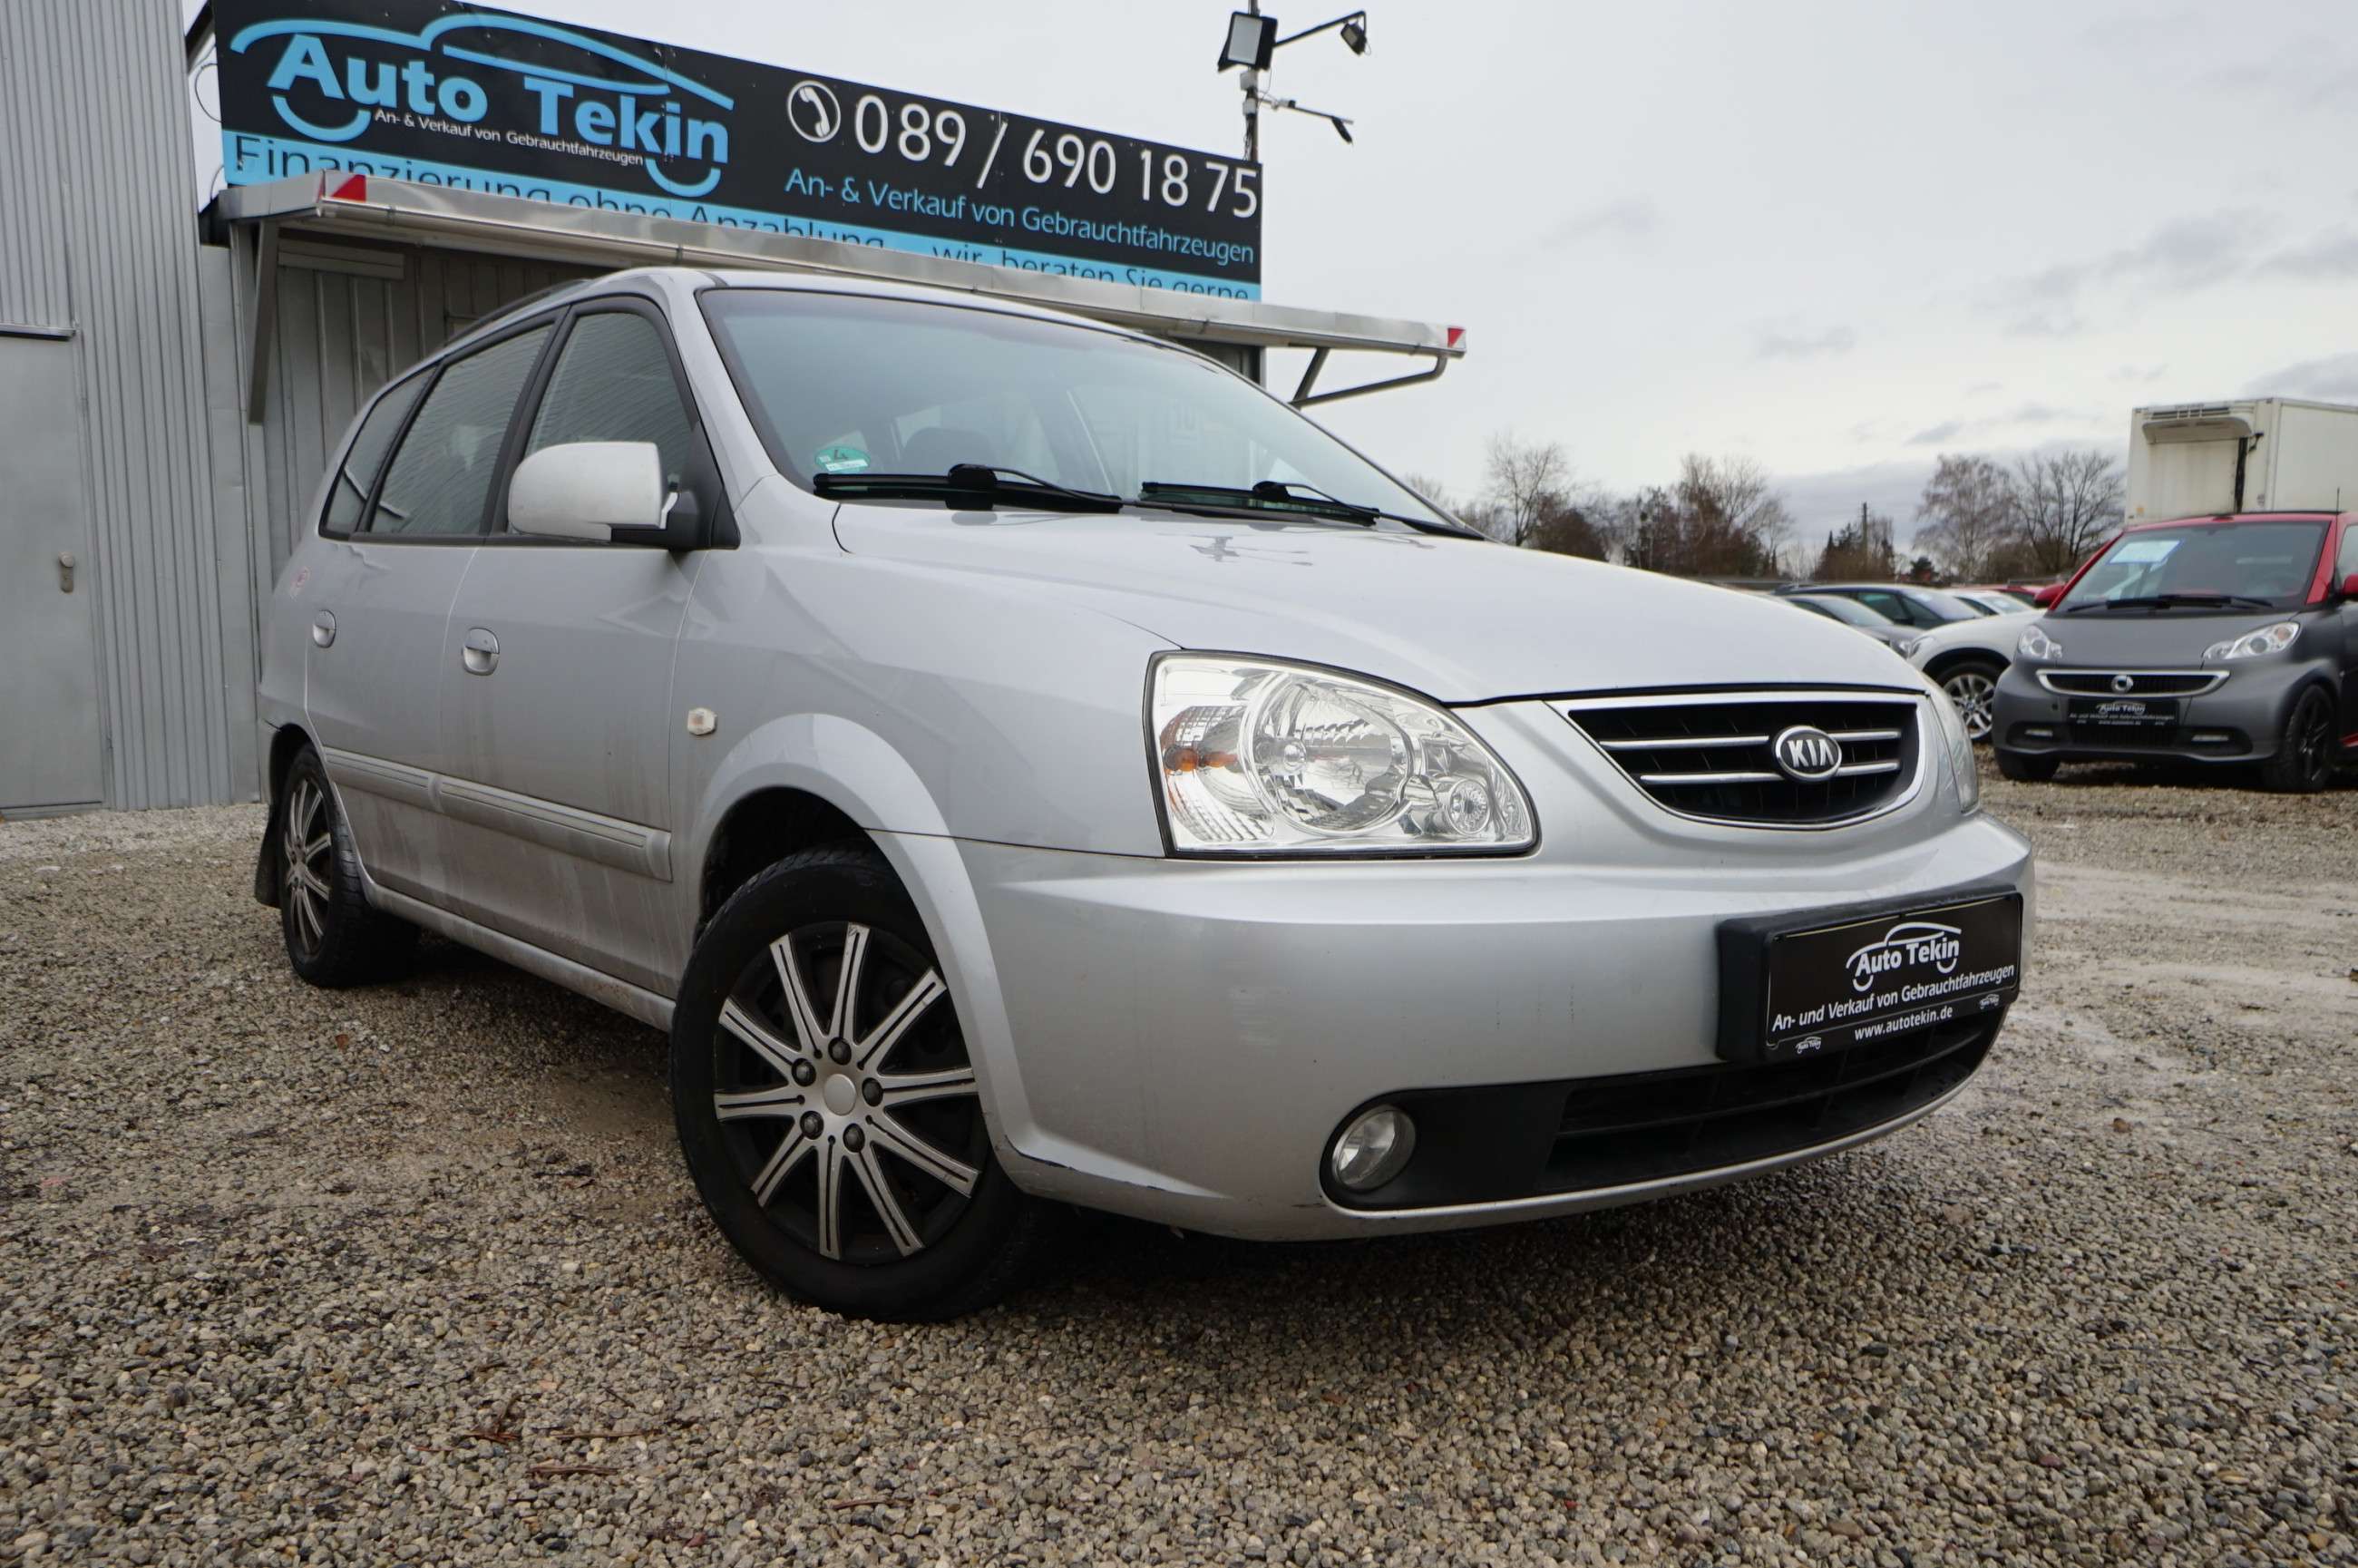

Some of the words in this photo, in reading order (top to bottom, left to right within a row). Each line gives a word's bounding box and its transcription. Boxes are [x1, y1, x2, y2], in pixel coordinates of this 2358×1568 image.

[268, 34, 488, 122] Auto
[524, 76, 728, 164] Tekin
[374, 108, 400, 125] An-
[404, 114, 415, 128] &
[418, 116, 473, 137] Verkauf
[474, 128, 501, 142] von
[506, 131, 644, 166] Gebrauchtfahrzeugen
[855, 94, 967, 168] 089
[976, 120, 1008, 190] /
[1023, 129, 1116, 195] 690
[1140, 149, 1189, 208] 18
[1204, 161, 1258, 219] 75
[784, 168, 833, 200] An-
[841, 177, 861, 204] &
[867, 180, 969, 222] Verkauf
[971, 203, 1015, 229] von
[1022, 207, 1254, 267] Gebrauchtfahrzeugen
[1787, 738, 1835, 767] KIA
[1855, 950, 1902, 978] Auto
[1905, 938, 1959, 965] Tekin
[1771, 1013, 1796, 1033] An-
[1798, 1004, 1825, 1026] und
[1828, 995, 1875, 1019] Verkauf
[1877, 991, 1898, 1008] von
[1901, 963, 2014, 1002] Gebrauchtfahrzeugen
[1855, 1006, 1953, 1042] www.autotekin.de
